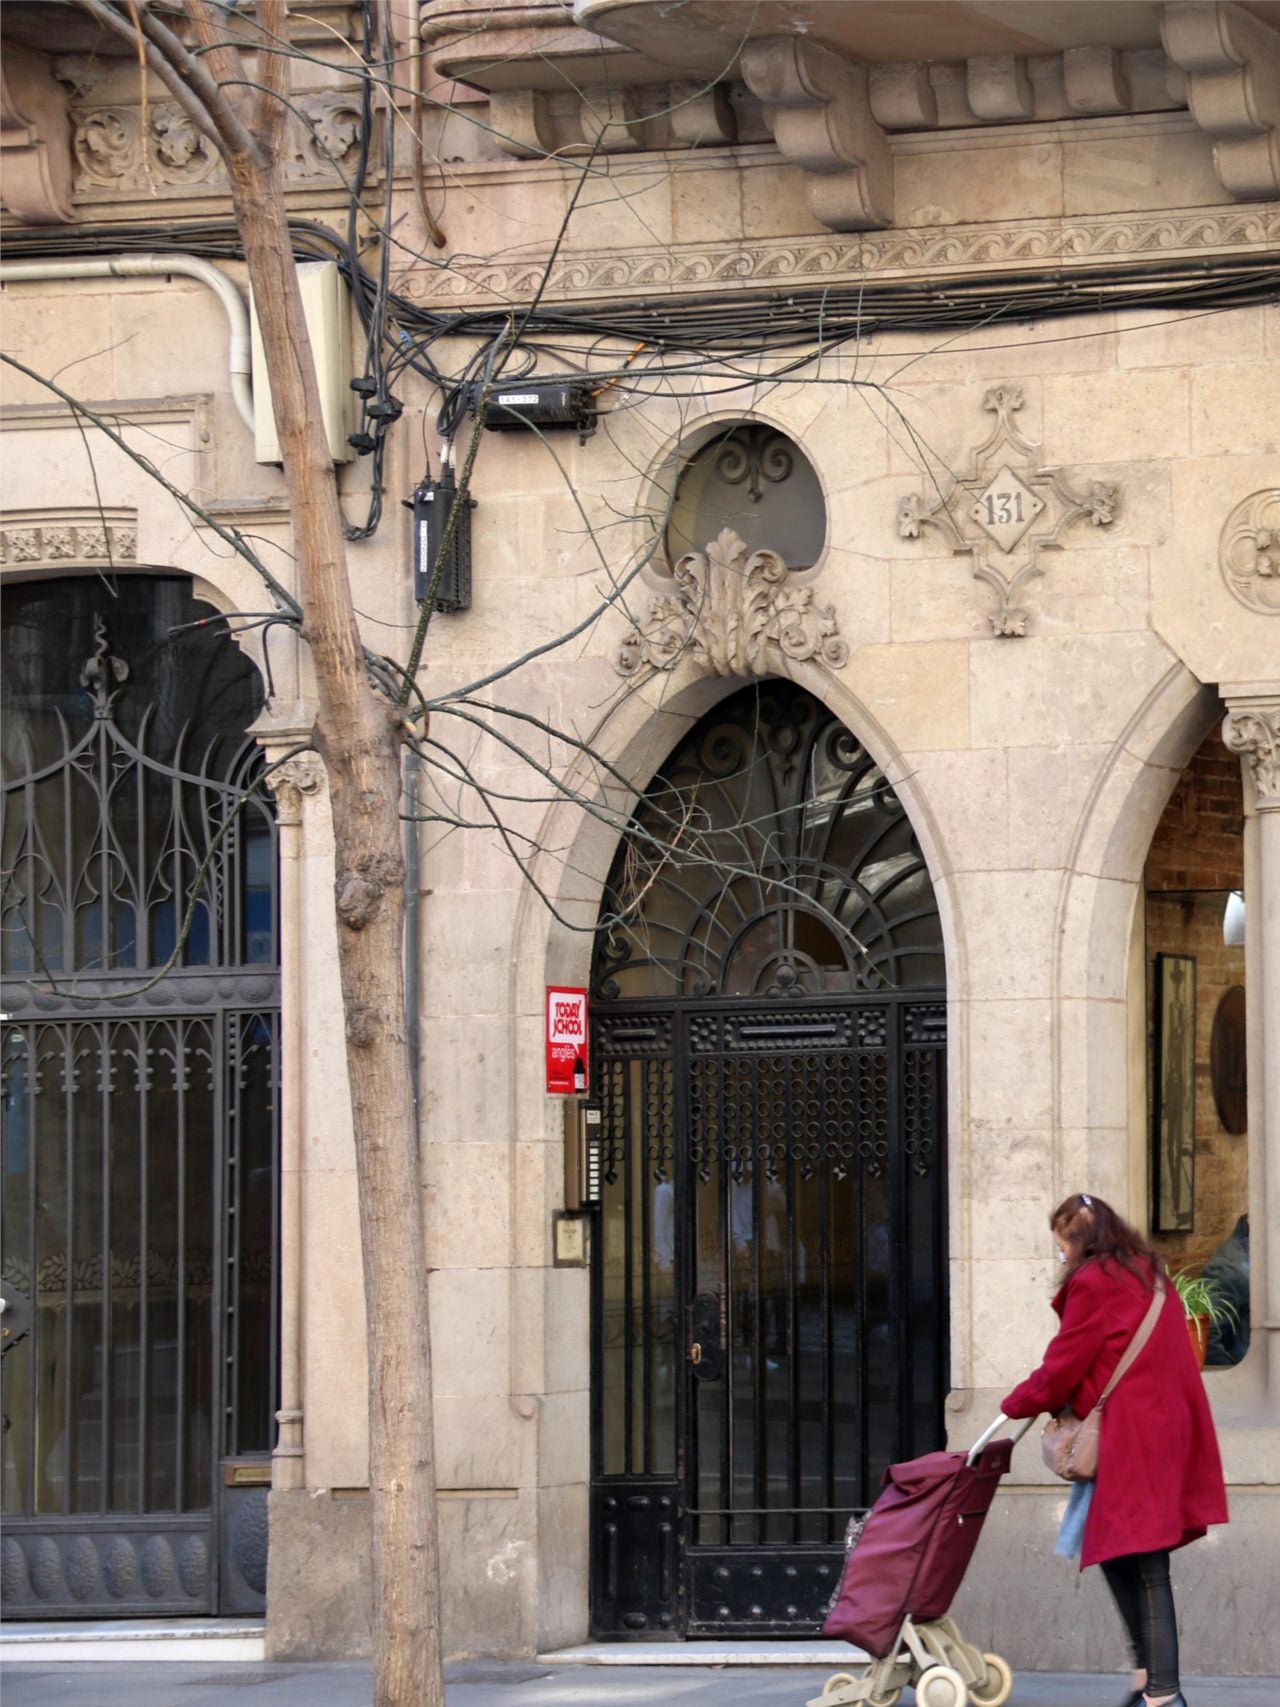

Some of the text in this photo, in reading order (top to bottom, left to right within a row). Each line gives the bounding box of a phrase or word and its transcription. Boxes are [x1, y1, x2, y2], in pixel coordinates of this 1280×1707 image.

[985, 491, 1025, 526] 131
[555, 1000, 582, 1019] TODAY
[552, 1017, 582, 1037] SCHOOL
